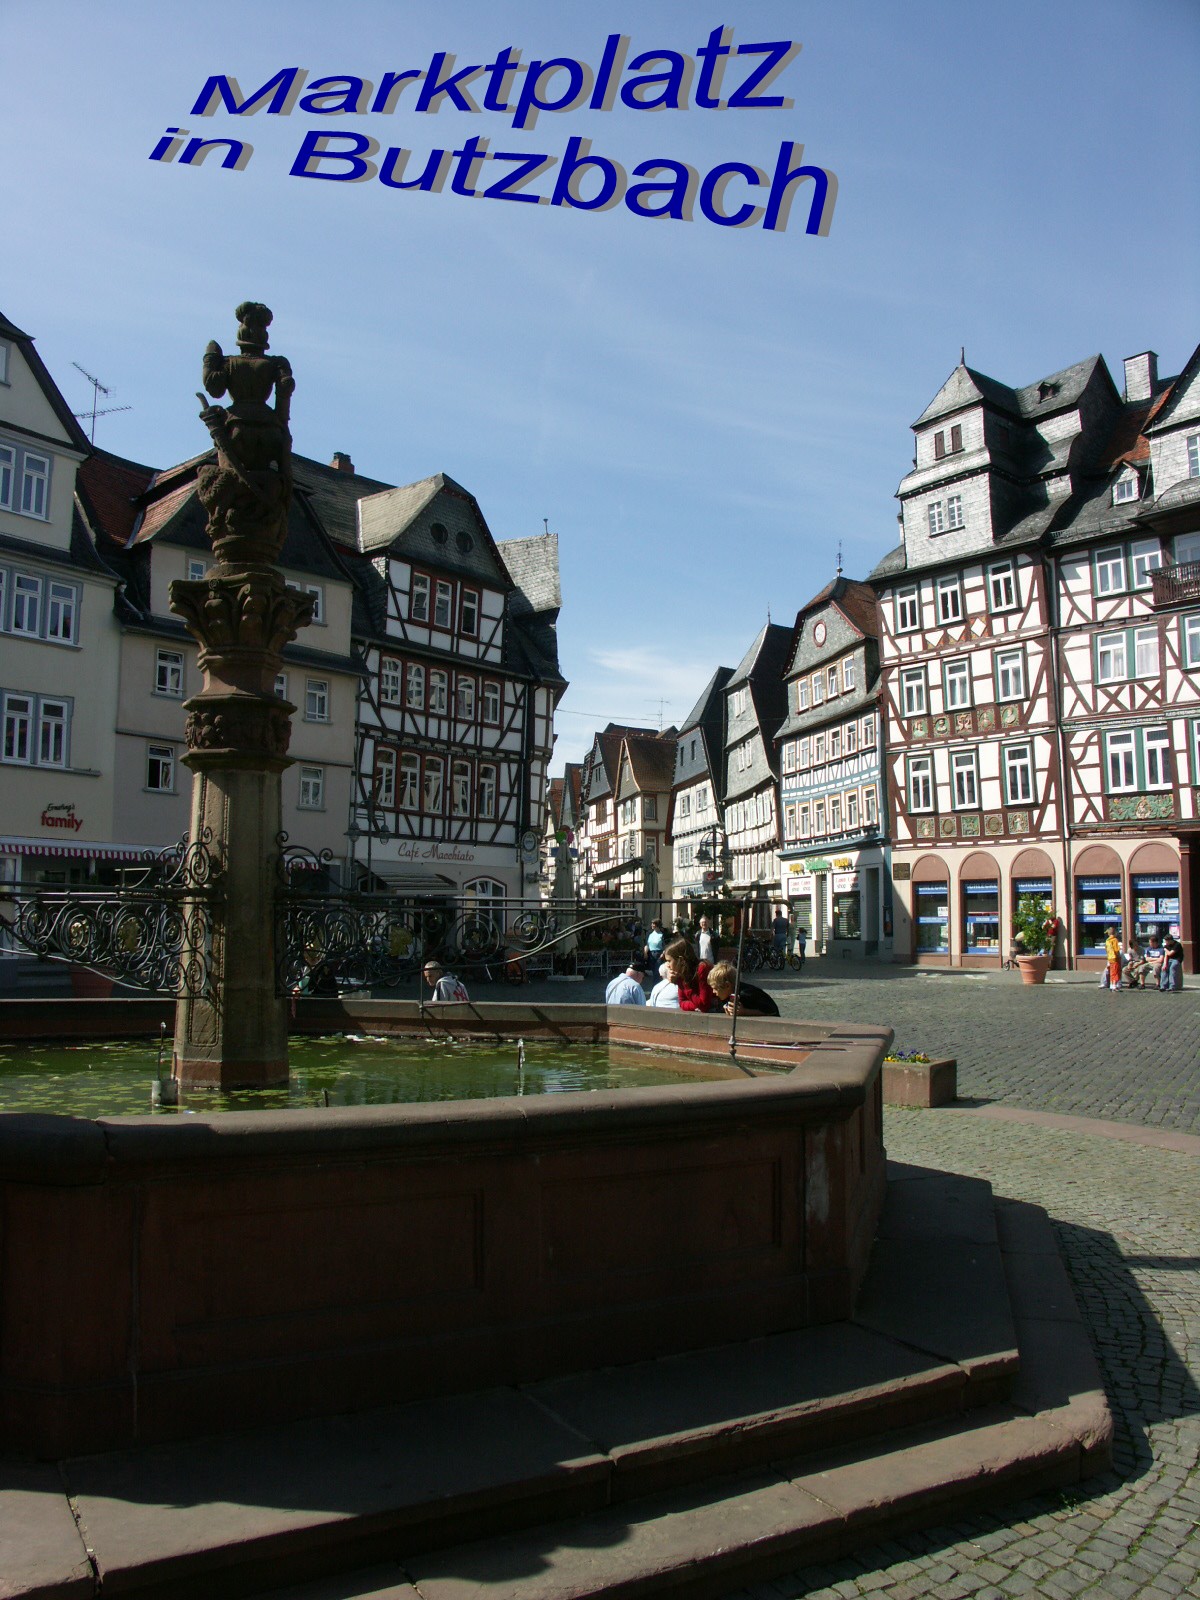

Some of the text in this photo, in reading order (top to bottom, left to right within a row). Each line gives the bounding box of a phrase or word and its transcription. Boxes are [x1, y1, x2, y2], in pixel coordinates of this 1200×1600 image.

[41, 810, 83, 832] family
[398, 842, 475, 861] Café Macchiato
